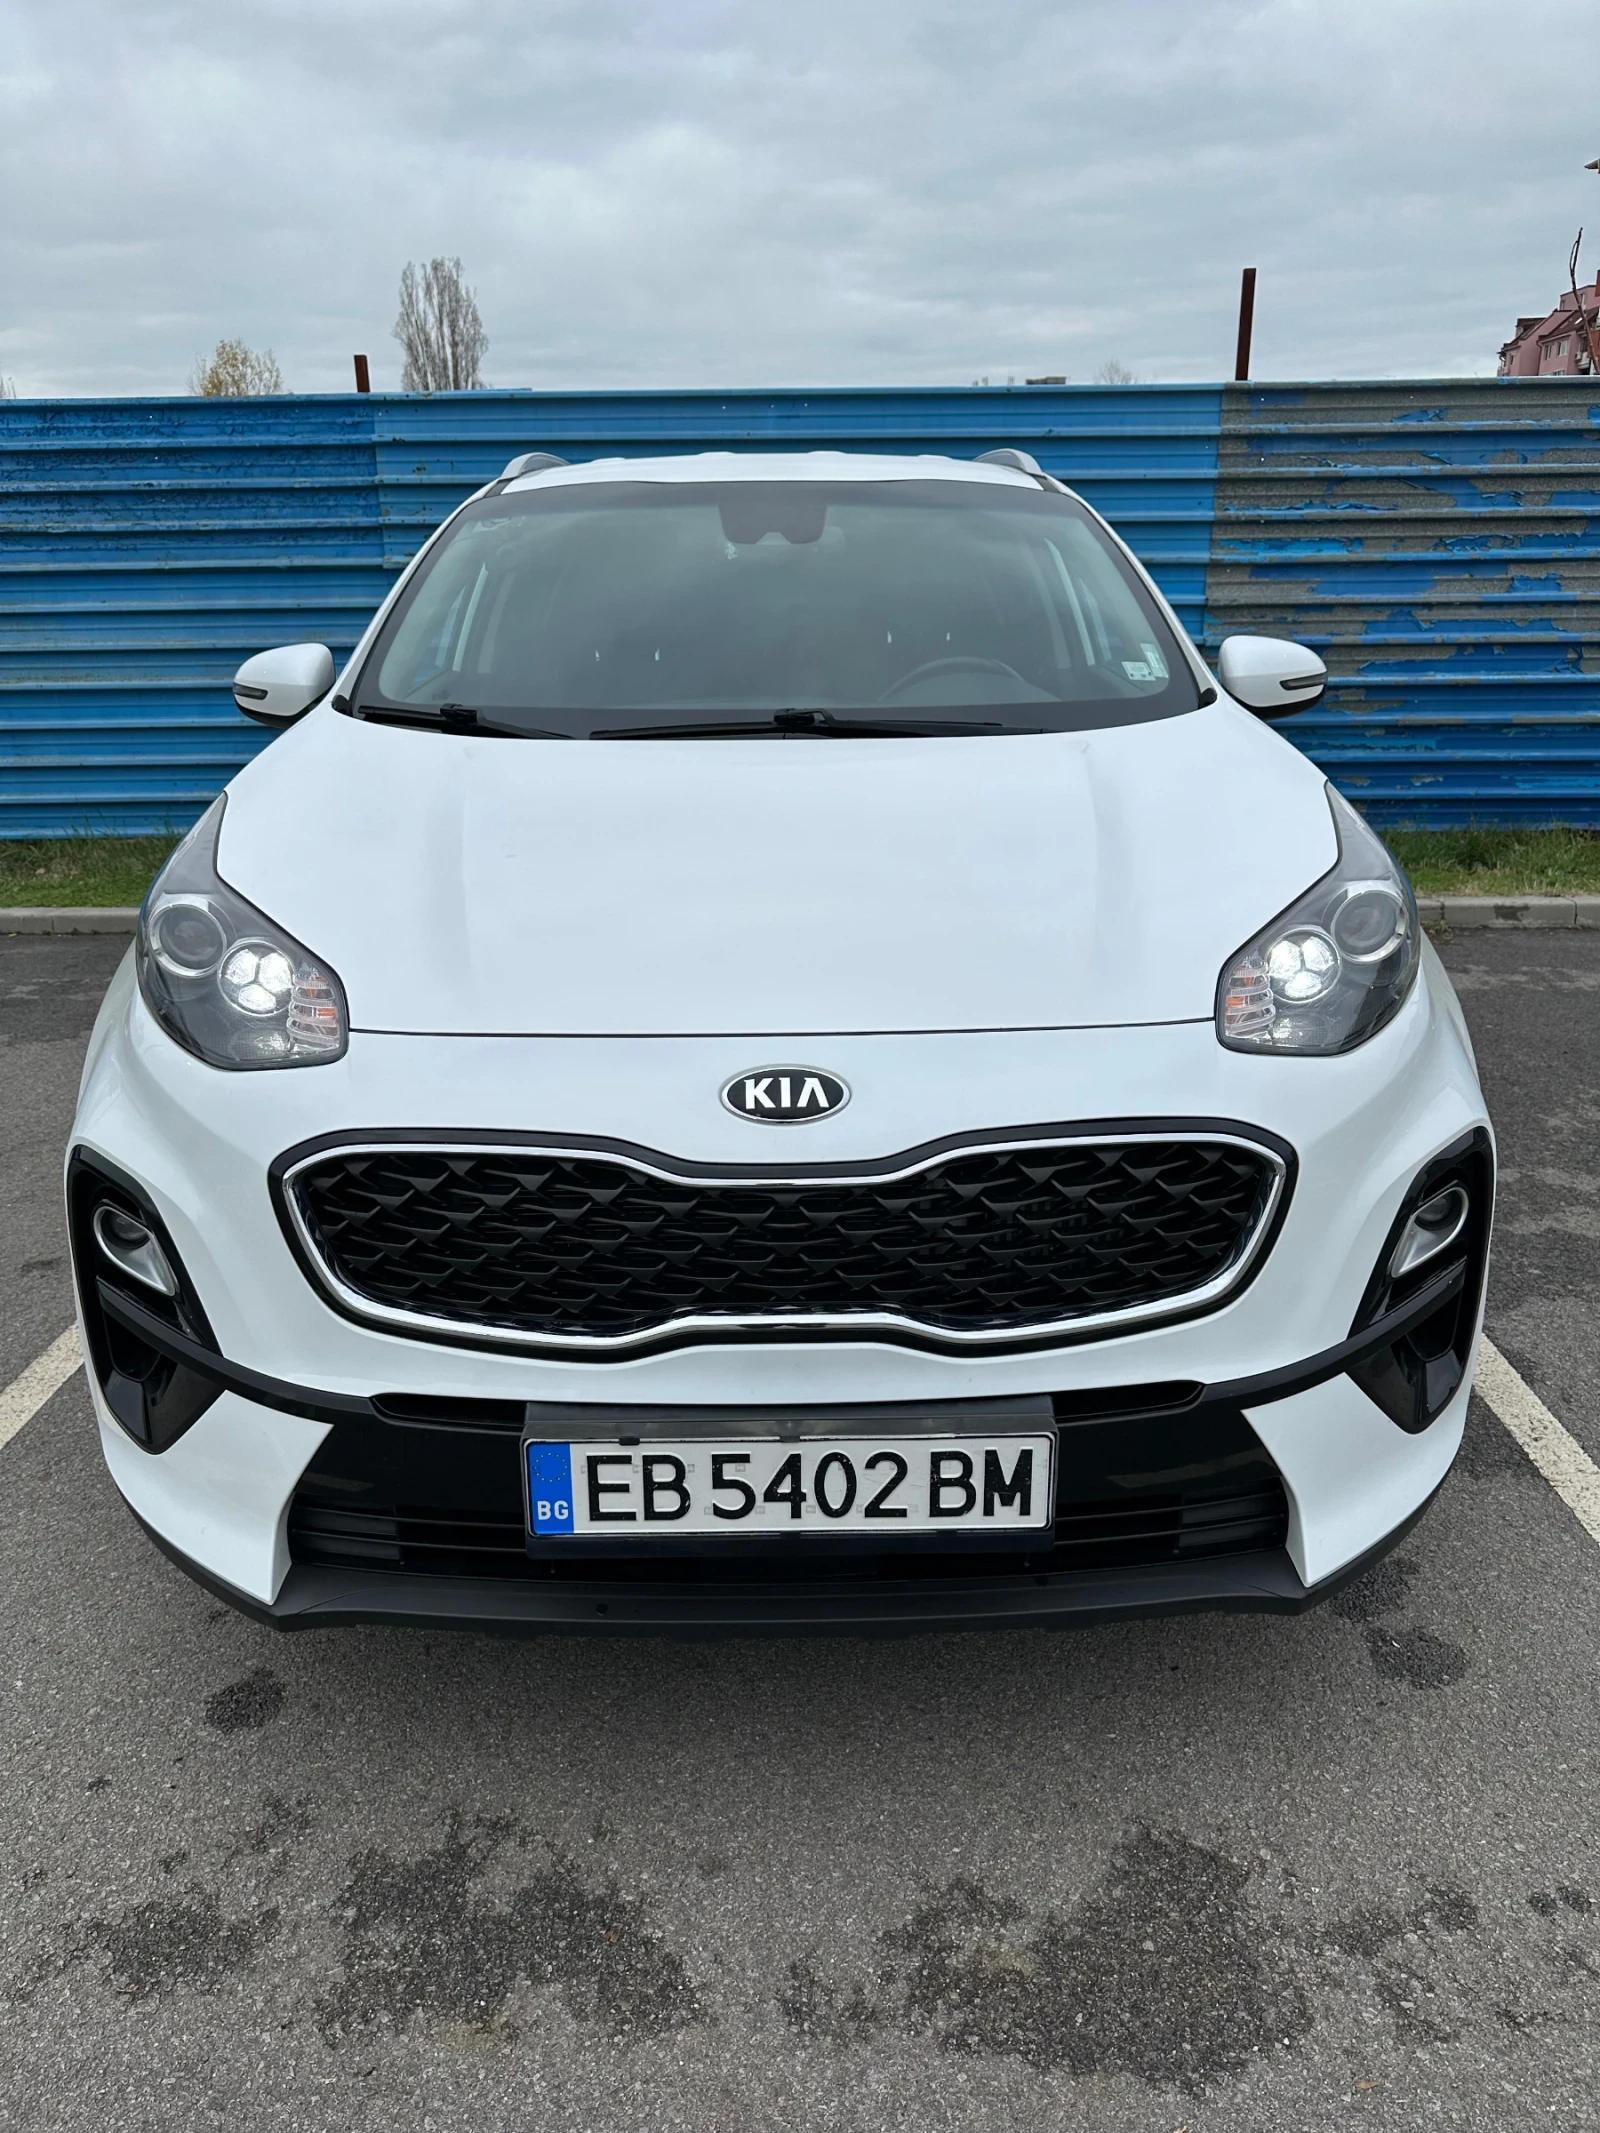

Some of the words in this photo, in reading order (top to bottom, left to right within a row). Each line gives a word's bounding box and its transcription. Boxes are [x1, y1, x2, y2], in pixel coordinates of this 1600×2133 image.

[743, 1077, 830, 1109] KIA
[586, 1453, 691, 1522] EB
[711, 1450, 909, 1520] 5402
[928, 1448, 1033, 1518] BM
[536, 1500, 569, 1521] BG
